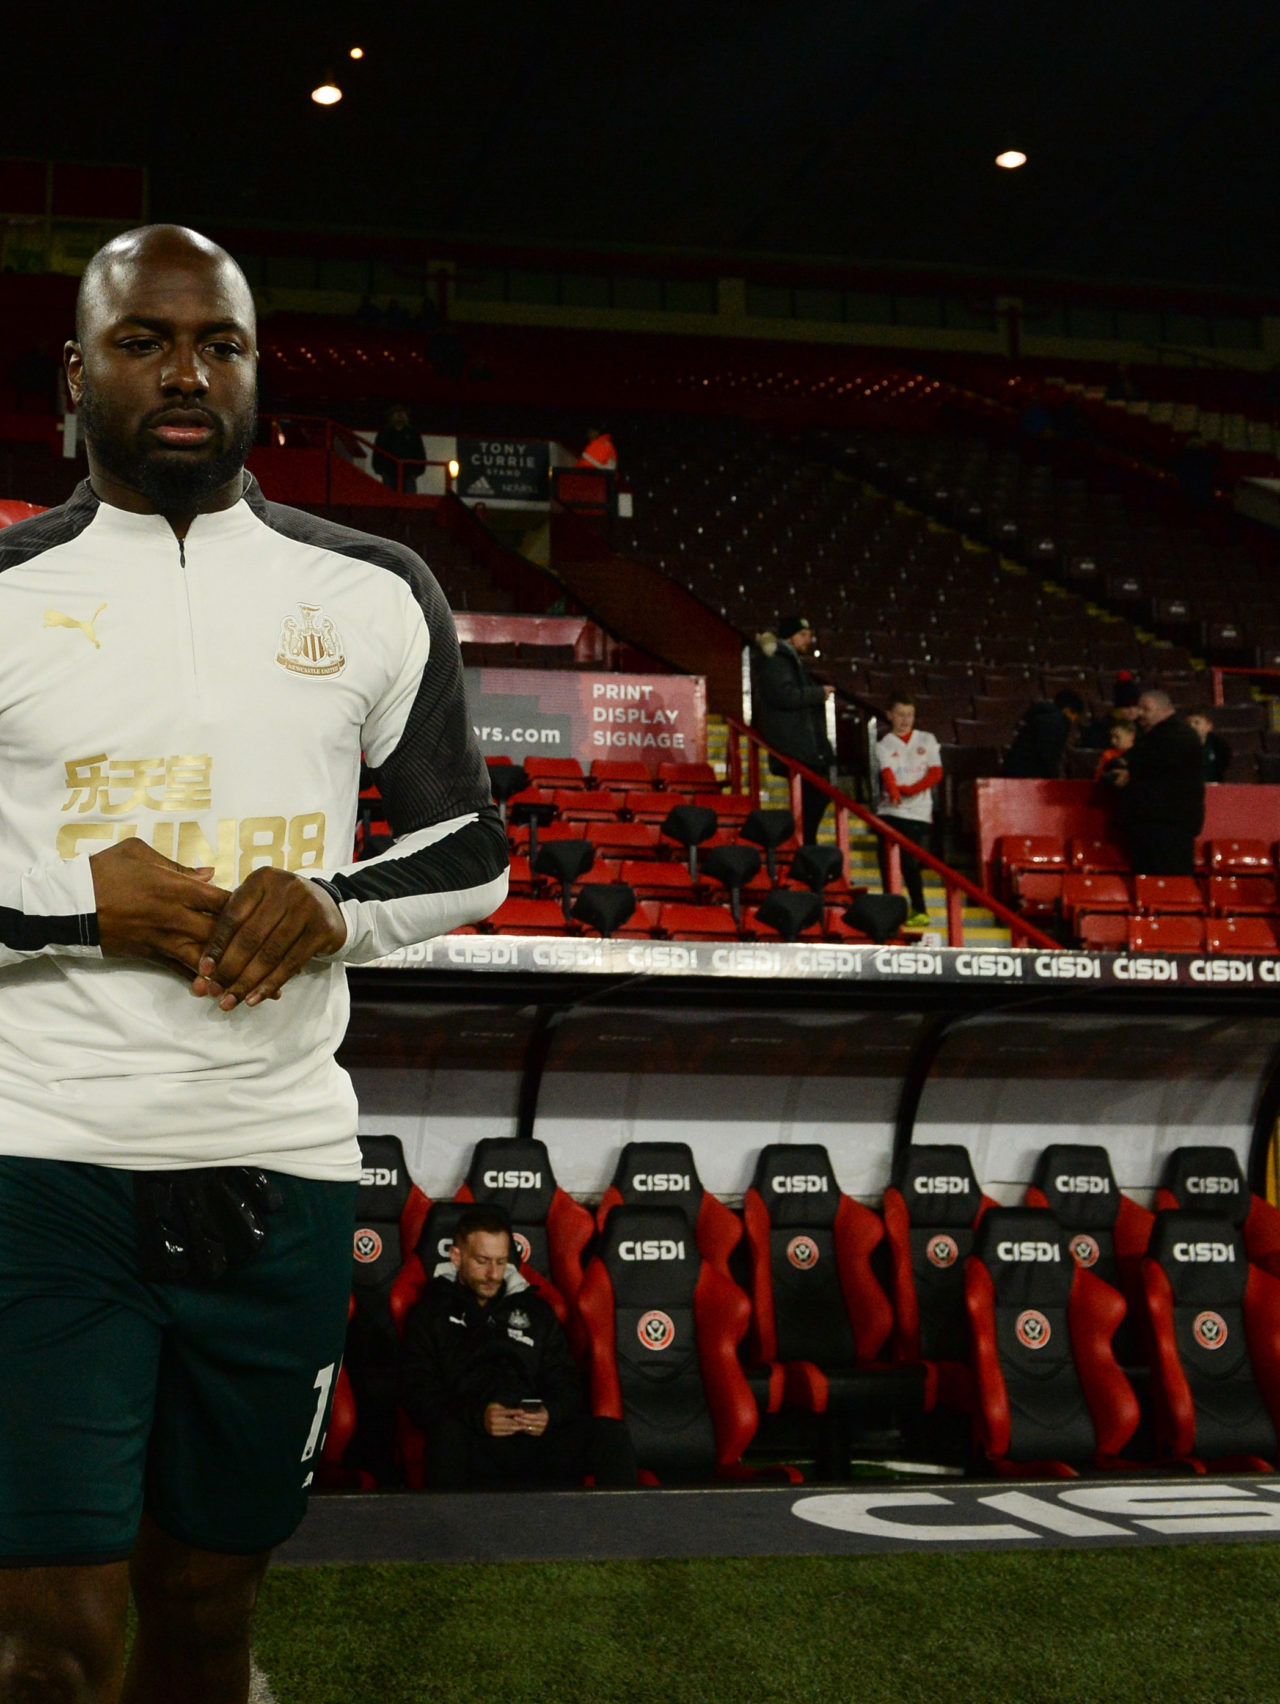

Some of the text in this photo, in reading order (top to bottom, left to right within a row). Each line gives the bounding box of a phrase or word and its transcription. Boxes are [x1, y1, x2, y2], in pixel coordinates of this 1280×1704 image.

[479, 442, 528, 455] TONY
[471, 454, 536, 468] CURRIE
[592, 683, 654, 700] PRINT
[593, 707, 679, 725] DISPLAY
[593, 731, 685, 749] SIGNAGE
[448, 944, 518, 965] CISDI
[533, 945, 602, 966] CISDI
[628, 946, 697, 968] CISDI
[711, 949, 781, 971] CISDI
[795, 951, 862, 973] CISDI
[876, 952, 942, 975] CISDI
[955, 955, 1022, 976] CISDI
[1035, 955, 1101, 978] CISDI
[1113, 958, 1178, 981] CISDI
[1189, 959, 1254, 982] CISDI
[359, 1168, 398, 1186] SDI
[484, 1171, 541, 1188] CISDI
[632, 1173, 690, 1191] CISDI
[771, 1175, 828, 1193] CISDI
[914, 1176, 970, 1194] CISDI
[1055, 1175, 1110, 1193] CISDI
[1186, 1176, 1239, 1195] CISDI
[618, 1240, 685, 1261] CISDI
[996, 1242, 1060, 1262] CISDI
[1173, 1242, 1235, 1263] CISDI
[791, 1484, 1280, 1541] CIS
